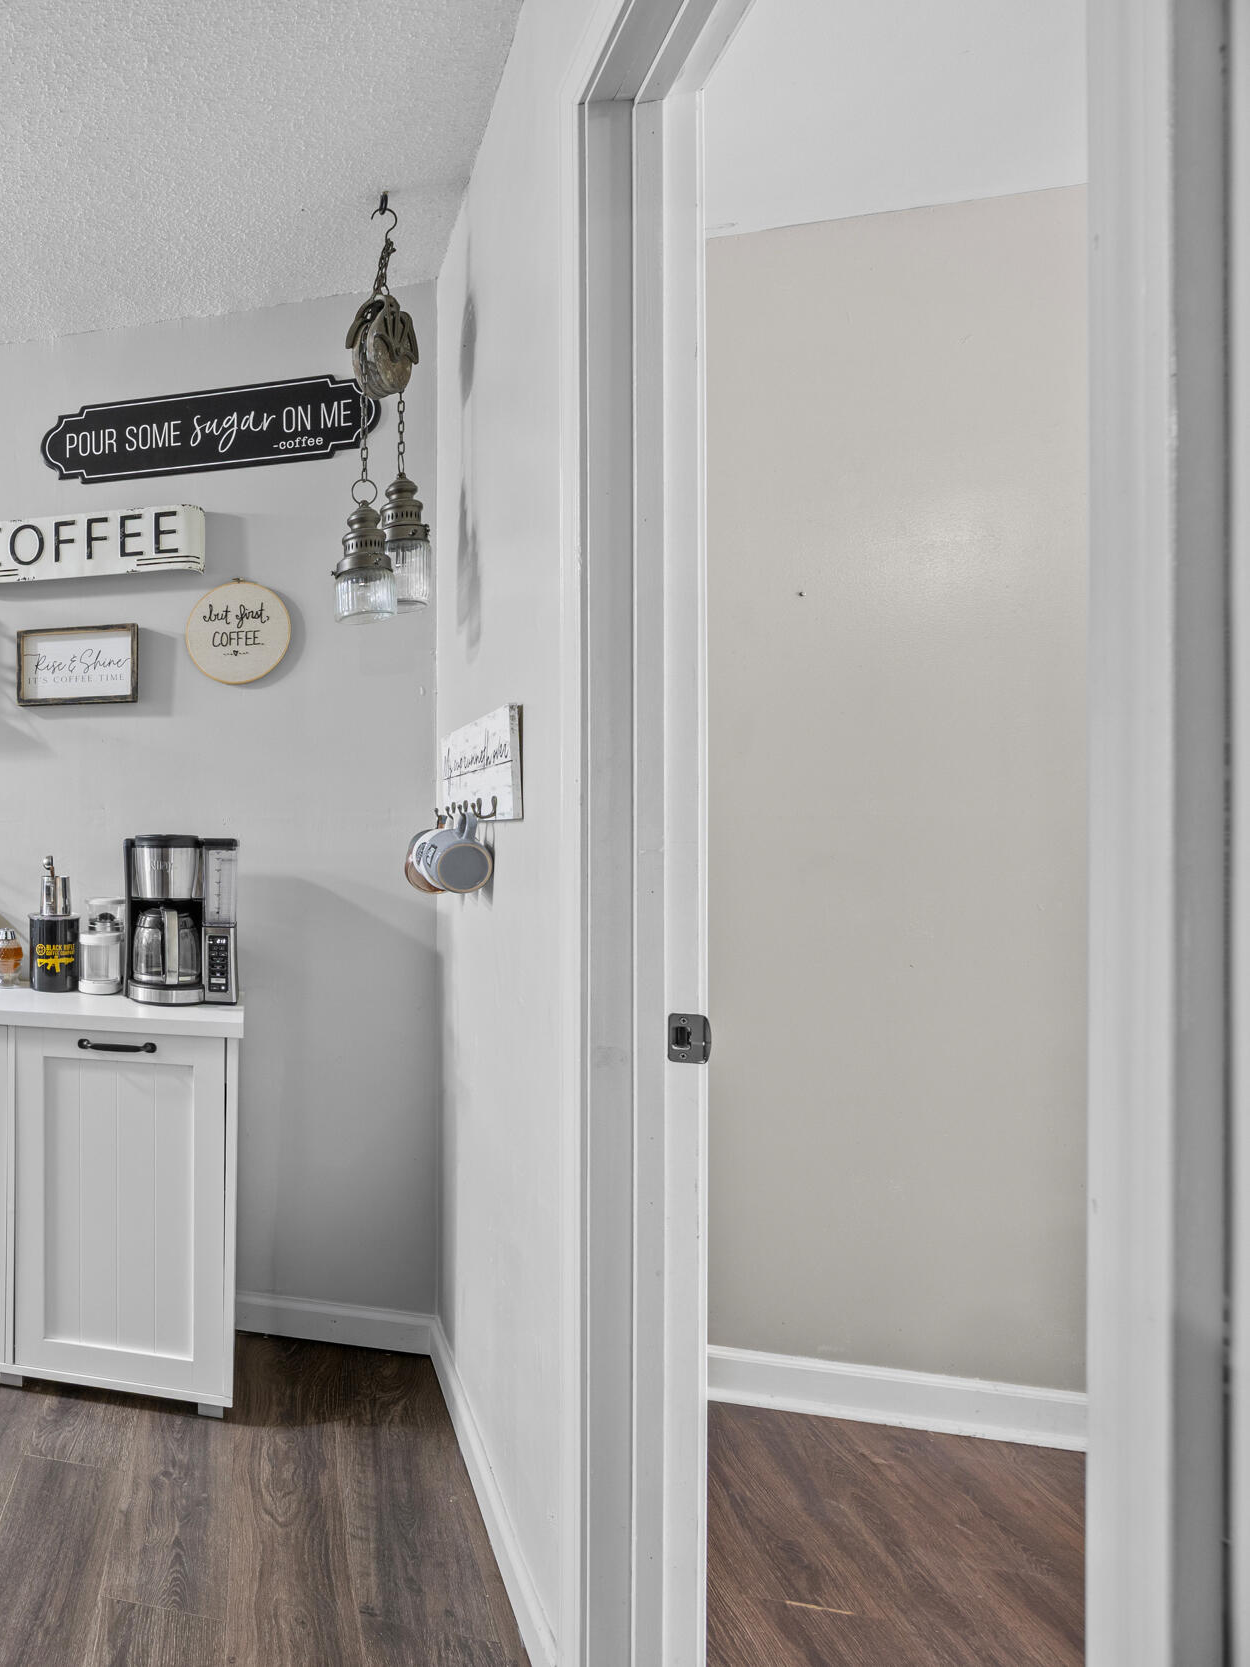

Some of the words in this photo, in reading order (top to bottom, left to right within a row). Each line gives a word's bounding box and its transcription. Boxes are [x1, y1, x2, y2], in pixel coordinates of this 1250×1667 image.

[65, 427, 118, 458] POUR
[125, 421, 182, 450] SOME
[190, 409, 276, 453] sugar
[282, 405, 312, 433] ON
[320, 399, 354, 428] ME
[273, 435, 325, 450] -coffee
[202, 603, 231, 625] but
[211, 630, 265, 648] COFFEE.
[31, 653, 66, 675] Rise
[67, 652, 78, 674] &
[79, 648, 127, 674] Shine
[28, 676, 49, 685] IT'S
[53, 674, 93, 684] COFFEE
[97, 673, 125, 682] TIME
